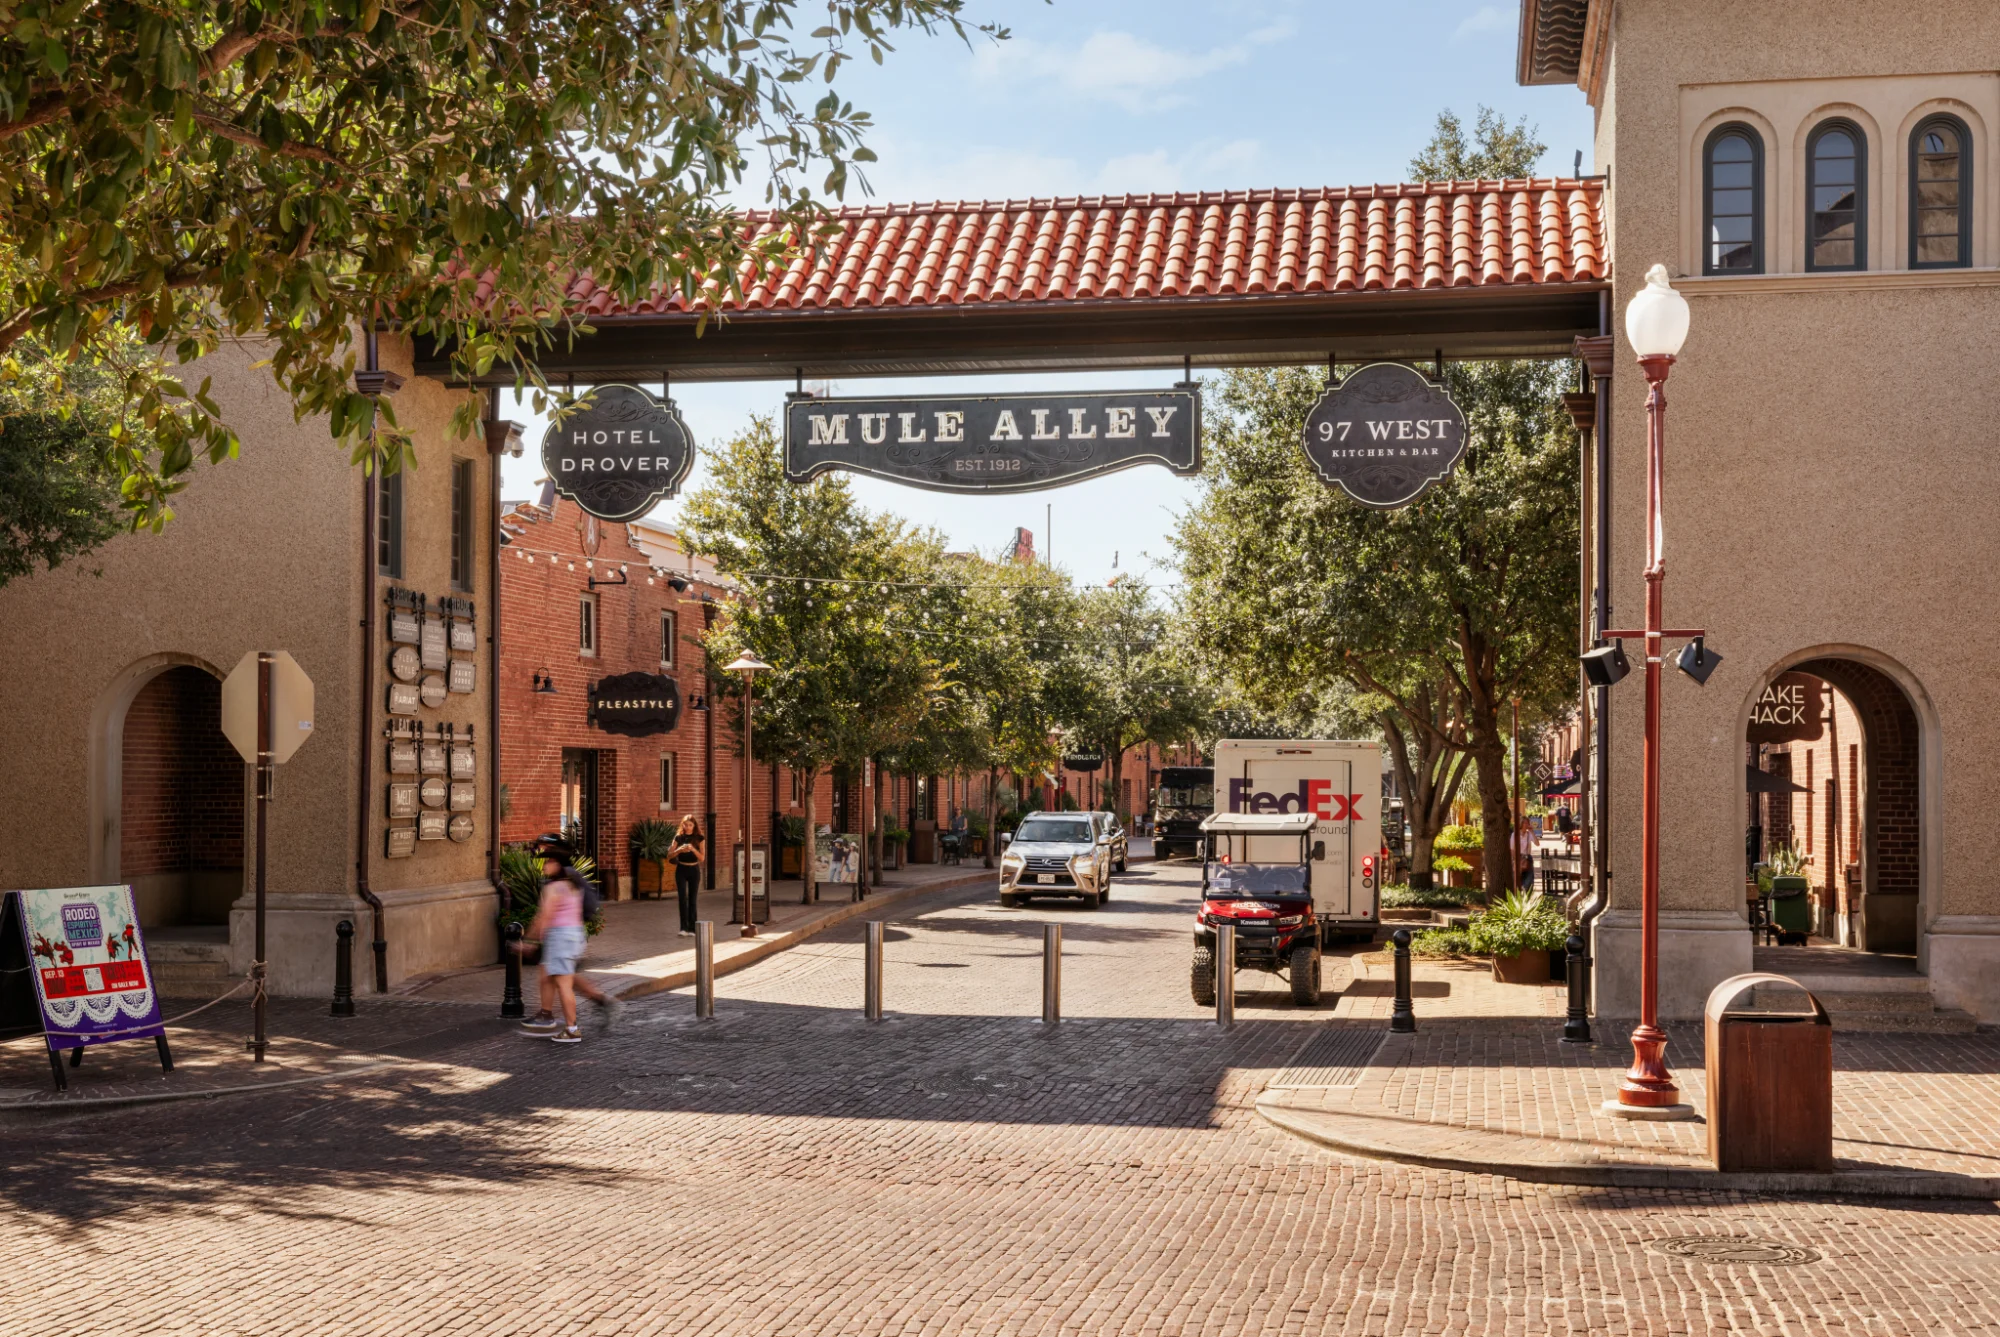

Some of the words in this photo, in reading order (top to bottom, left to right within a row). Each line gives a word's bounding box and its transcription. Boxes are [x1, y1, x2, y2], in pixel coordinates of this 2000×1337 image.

[808, 411, 965, 445] MULE
[989, 406, 1178, 441] ALLEY
[1318, 421, 1352, 442] 97
[1365, 419, 1452, 441] WEST
[572, 430, 661, 445] HOTEL
[1332, 448, 1395, 458] KITCHEN
[1399, 448, 1408, 456] &
[1412, 447, 1439, 456] BAR
[561, 456, 670, 472] DROVER
[955, 459, 986, 471] EST.
[989, 459, 1021, 471] 1912
[399, 653, 413, 663] FLEA
[397, 665, 415, 675] STYLE
[598, 700, 673, 709] FLEASTYLE
[397, 790, 411, 806] MELT
[1229, 778, 1364, 820] FedEx
[1314, 825, 1348, 835] round
[64, 907, 96, 921] RODEO
